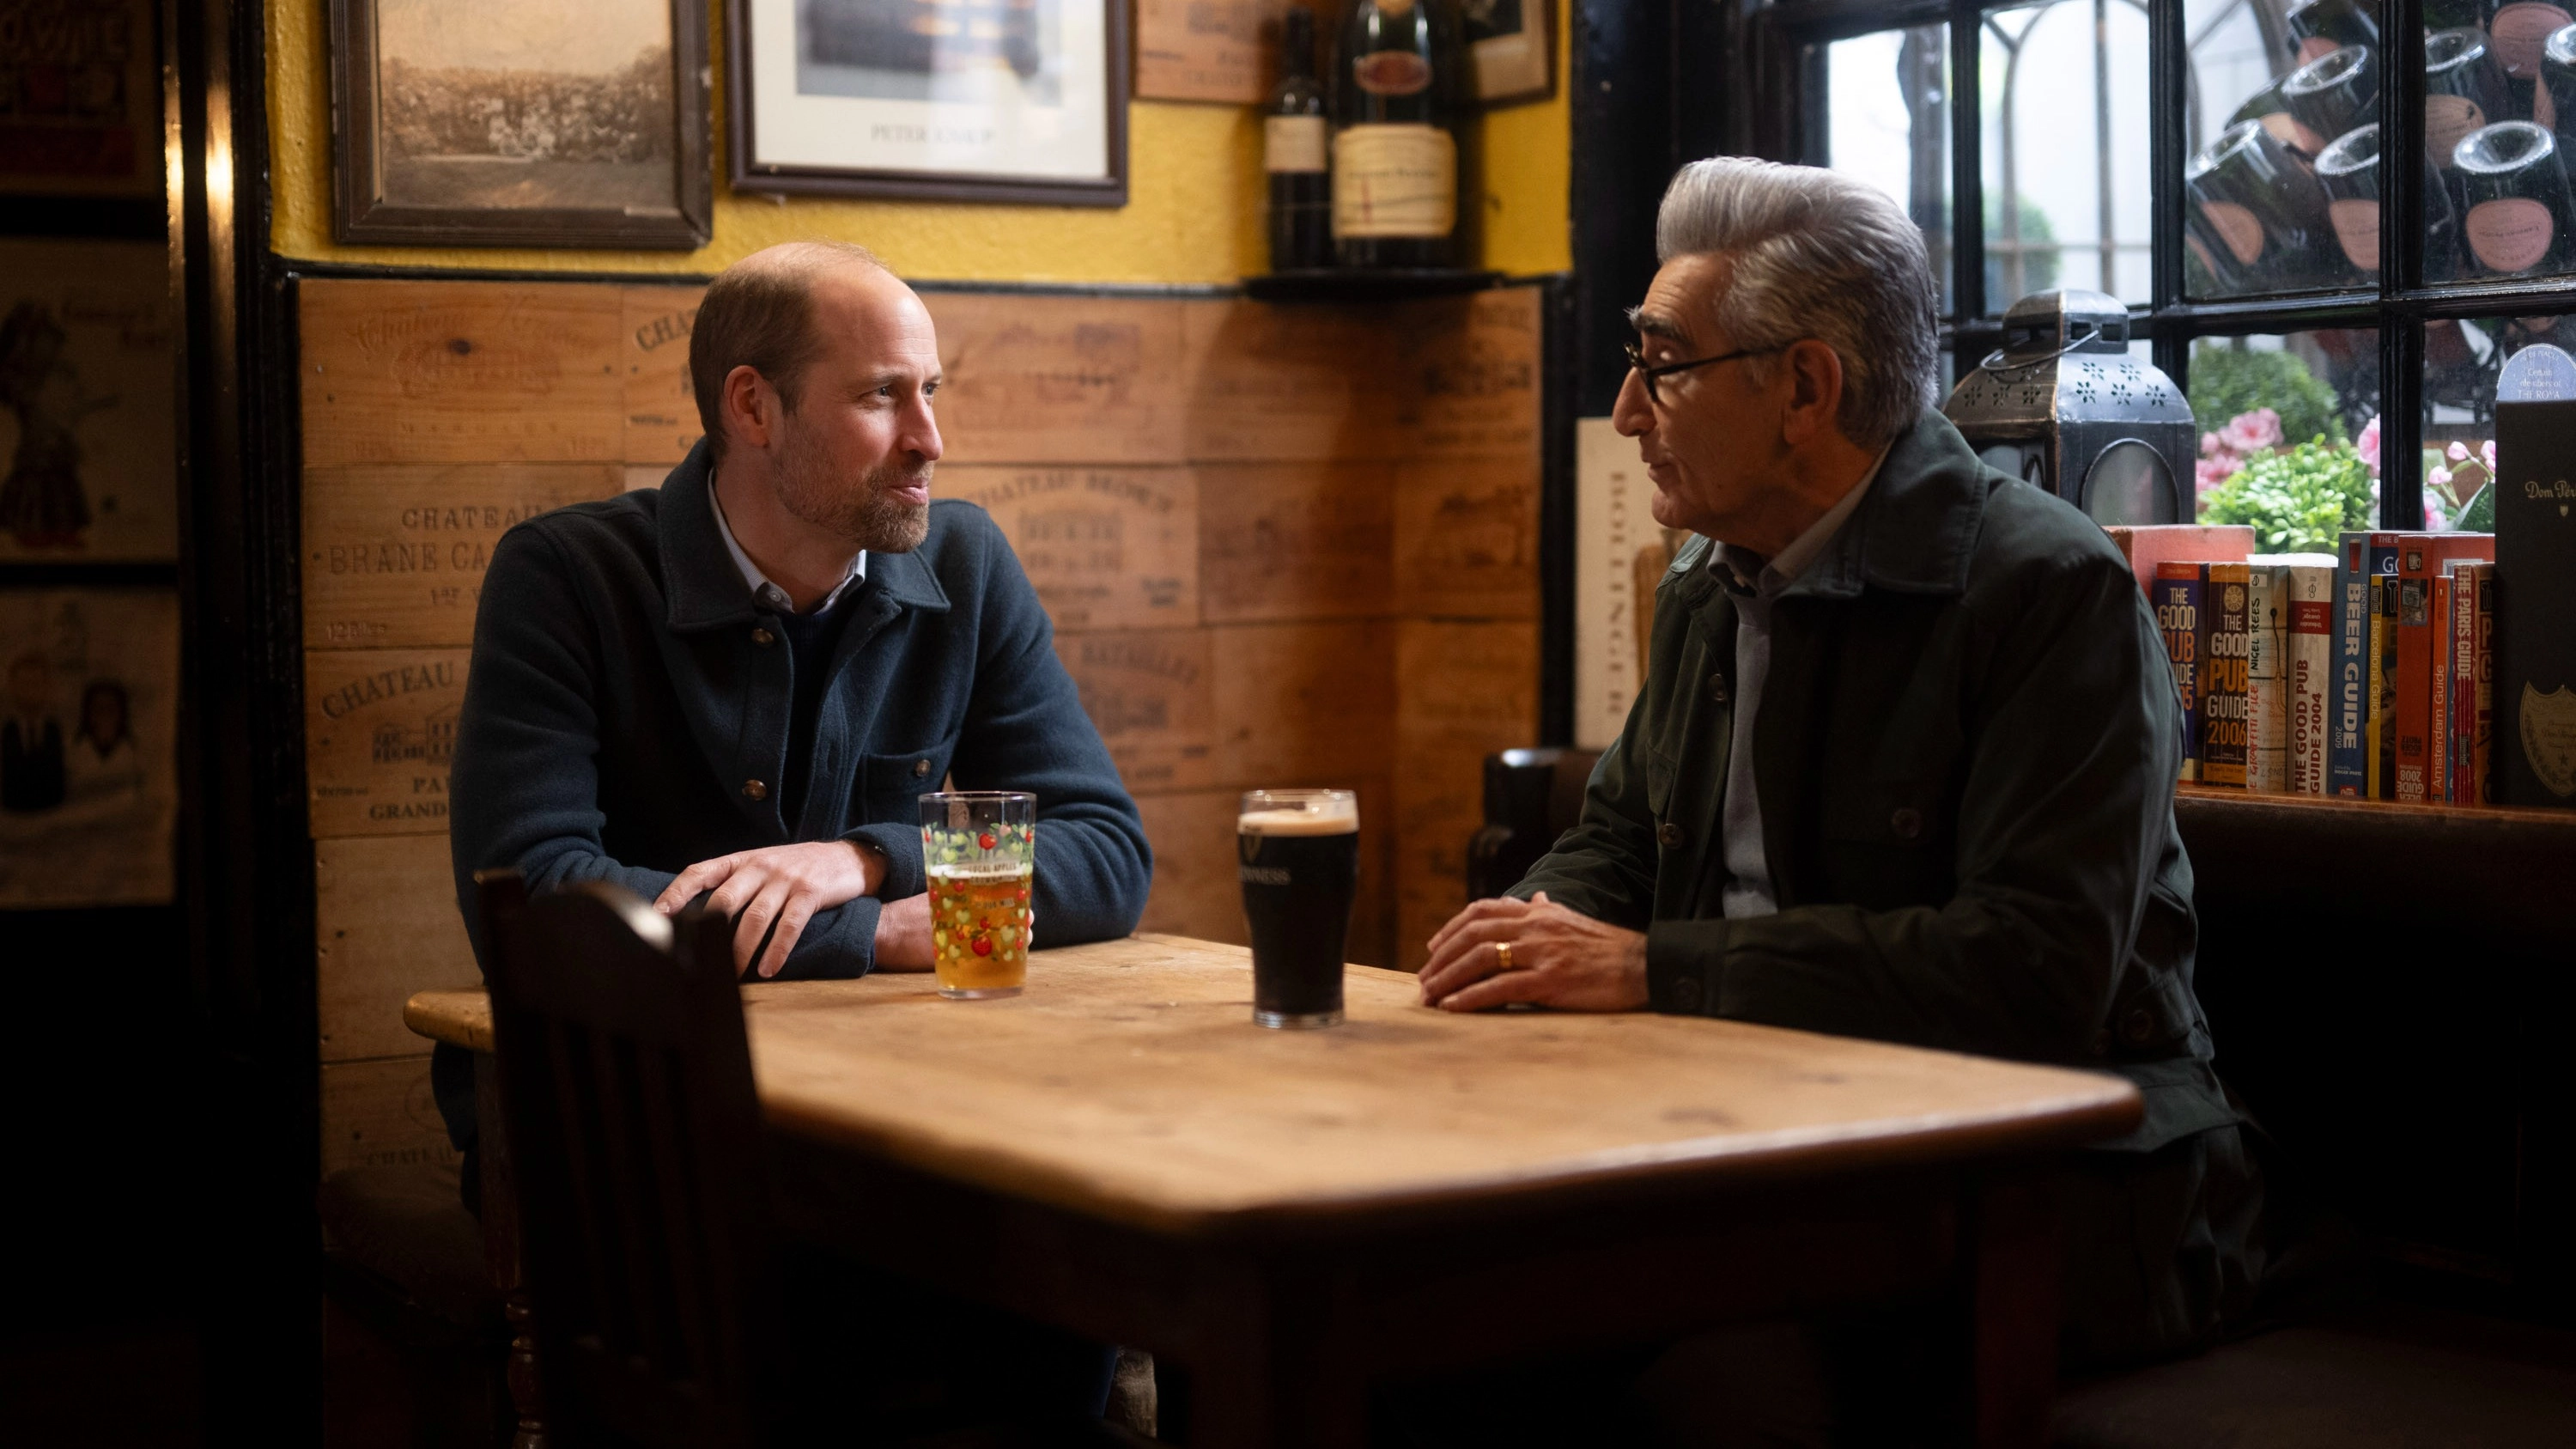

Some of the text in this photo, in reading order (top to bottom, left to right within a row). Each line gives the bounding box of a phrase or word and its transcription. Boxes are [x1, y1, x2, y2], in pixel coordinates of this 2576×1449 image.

[635, 309, 696, 353] CHA
[2524, 481, 2554, 498] Dom
[329, 541, 440, 575] BRANE
[2169, 588, 2189, 605] THE
[2158, 605, 2196, 630] GOOD
[2223, 614, 2242, 630] THE
[2457, 566, 2471, 680] THE PARIS GUIDE
[2211, 632, 2249, 657] GOOD
[2250, 598, 2261, 671] NIGEL REES
[2371, 619, 2381, 681] Barcelona
[2208, 659, 2248, 692] PUB
[2342, 583, 2361, 749] BEER GUIDE
[321, 661, 454, 720] CHATEAU
[2207, 695, 2248, 719] GUIDE
[2249, 684, 2259, 713] FILE
[2371, 684, 2381, 720] Guide
[2207, 721, 2247, 746] 2006
[2294, 660, 2309, 793] THE GOOD PUB
[2310, 692, 2323, 794] GUIDE 2004
[2433, 665, 2445, 788] Amsterdam Guide
[2249, 718, 2259, 775] GRAFFITI
[413, 777, 451, 794] PA
[2397, 781, 2425, 794] GUIDE
[2399, 770, 2422, 782] 2008
[369, 802, 447, 821] GRAND
